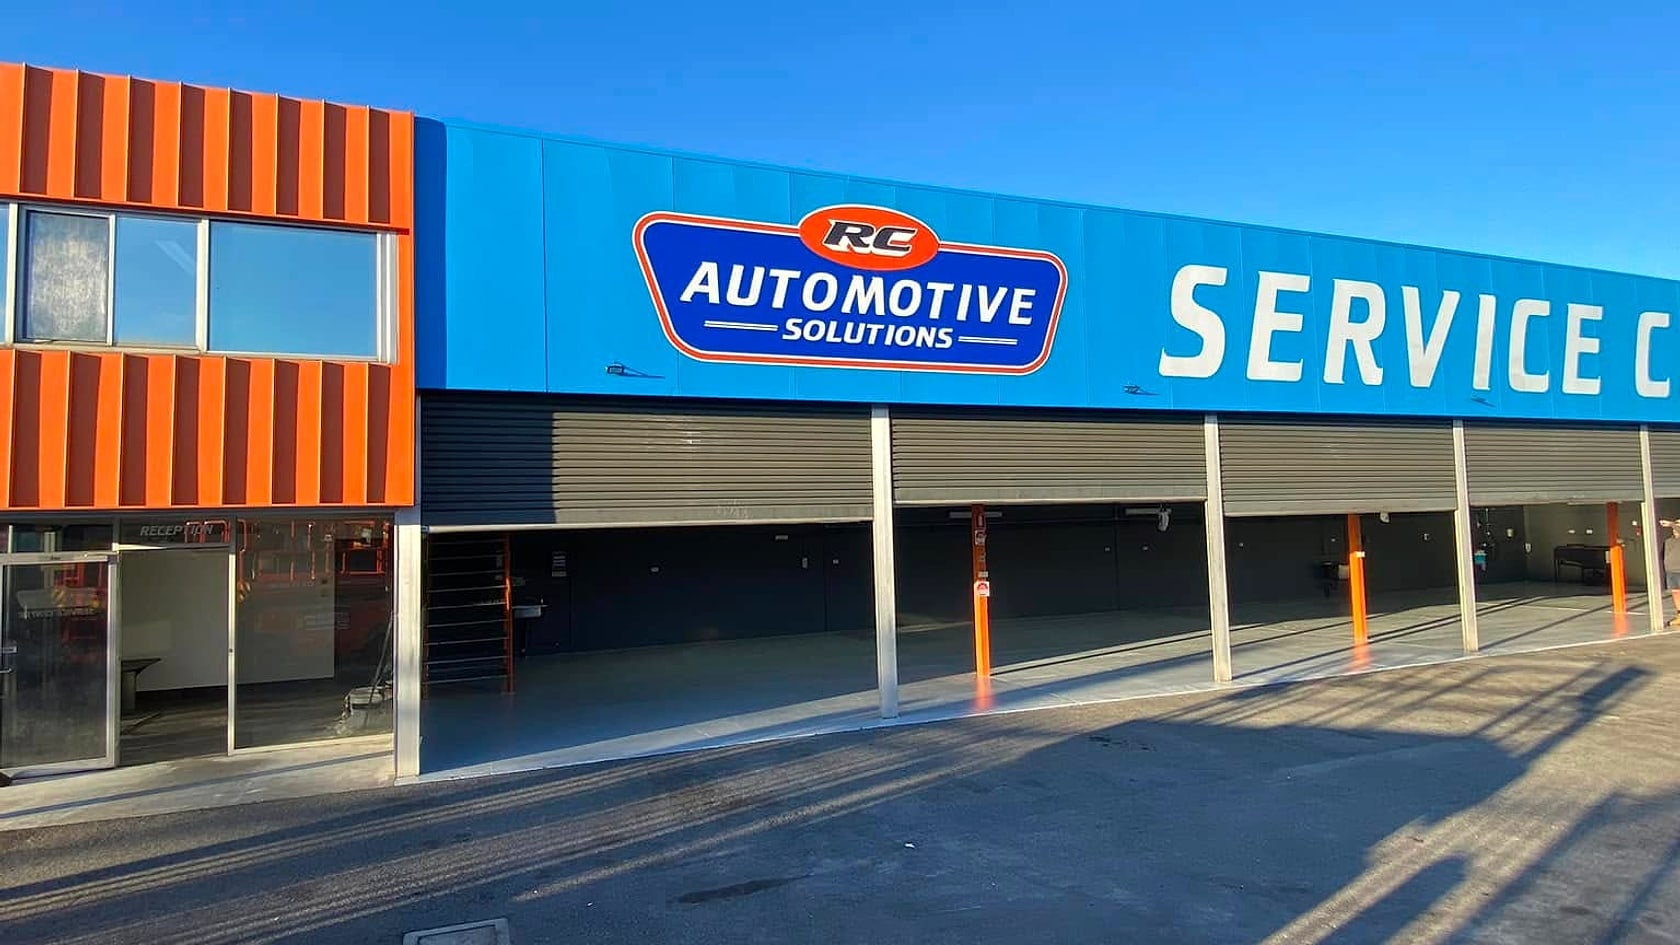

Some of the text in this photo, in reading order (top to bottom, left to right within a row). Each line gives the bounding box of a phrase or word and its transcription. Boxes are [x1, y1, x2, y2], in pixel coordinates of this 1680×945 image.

[822, 218, 917, 256] RC
[680, 260, 1037, 326] AUTOMOTIVE
[782, 318, 953, 349] SOLUTIONS
[1158, 264, 1603, 395] SERVICE
[140, 524, 214, 537] RECEPTION
